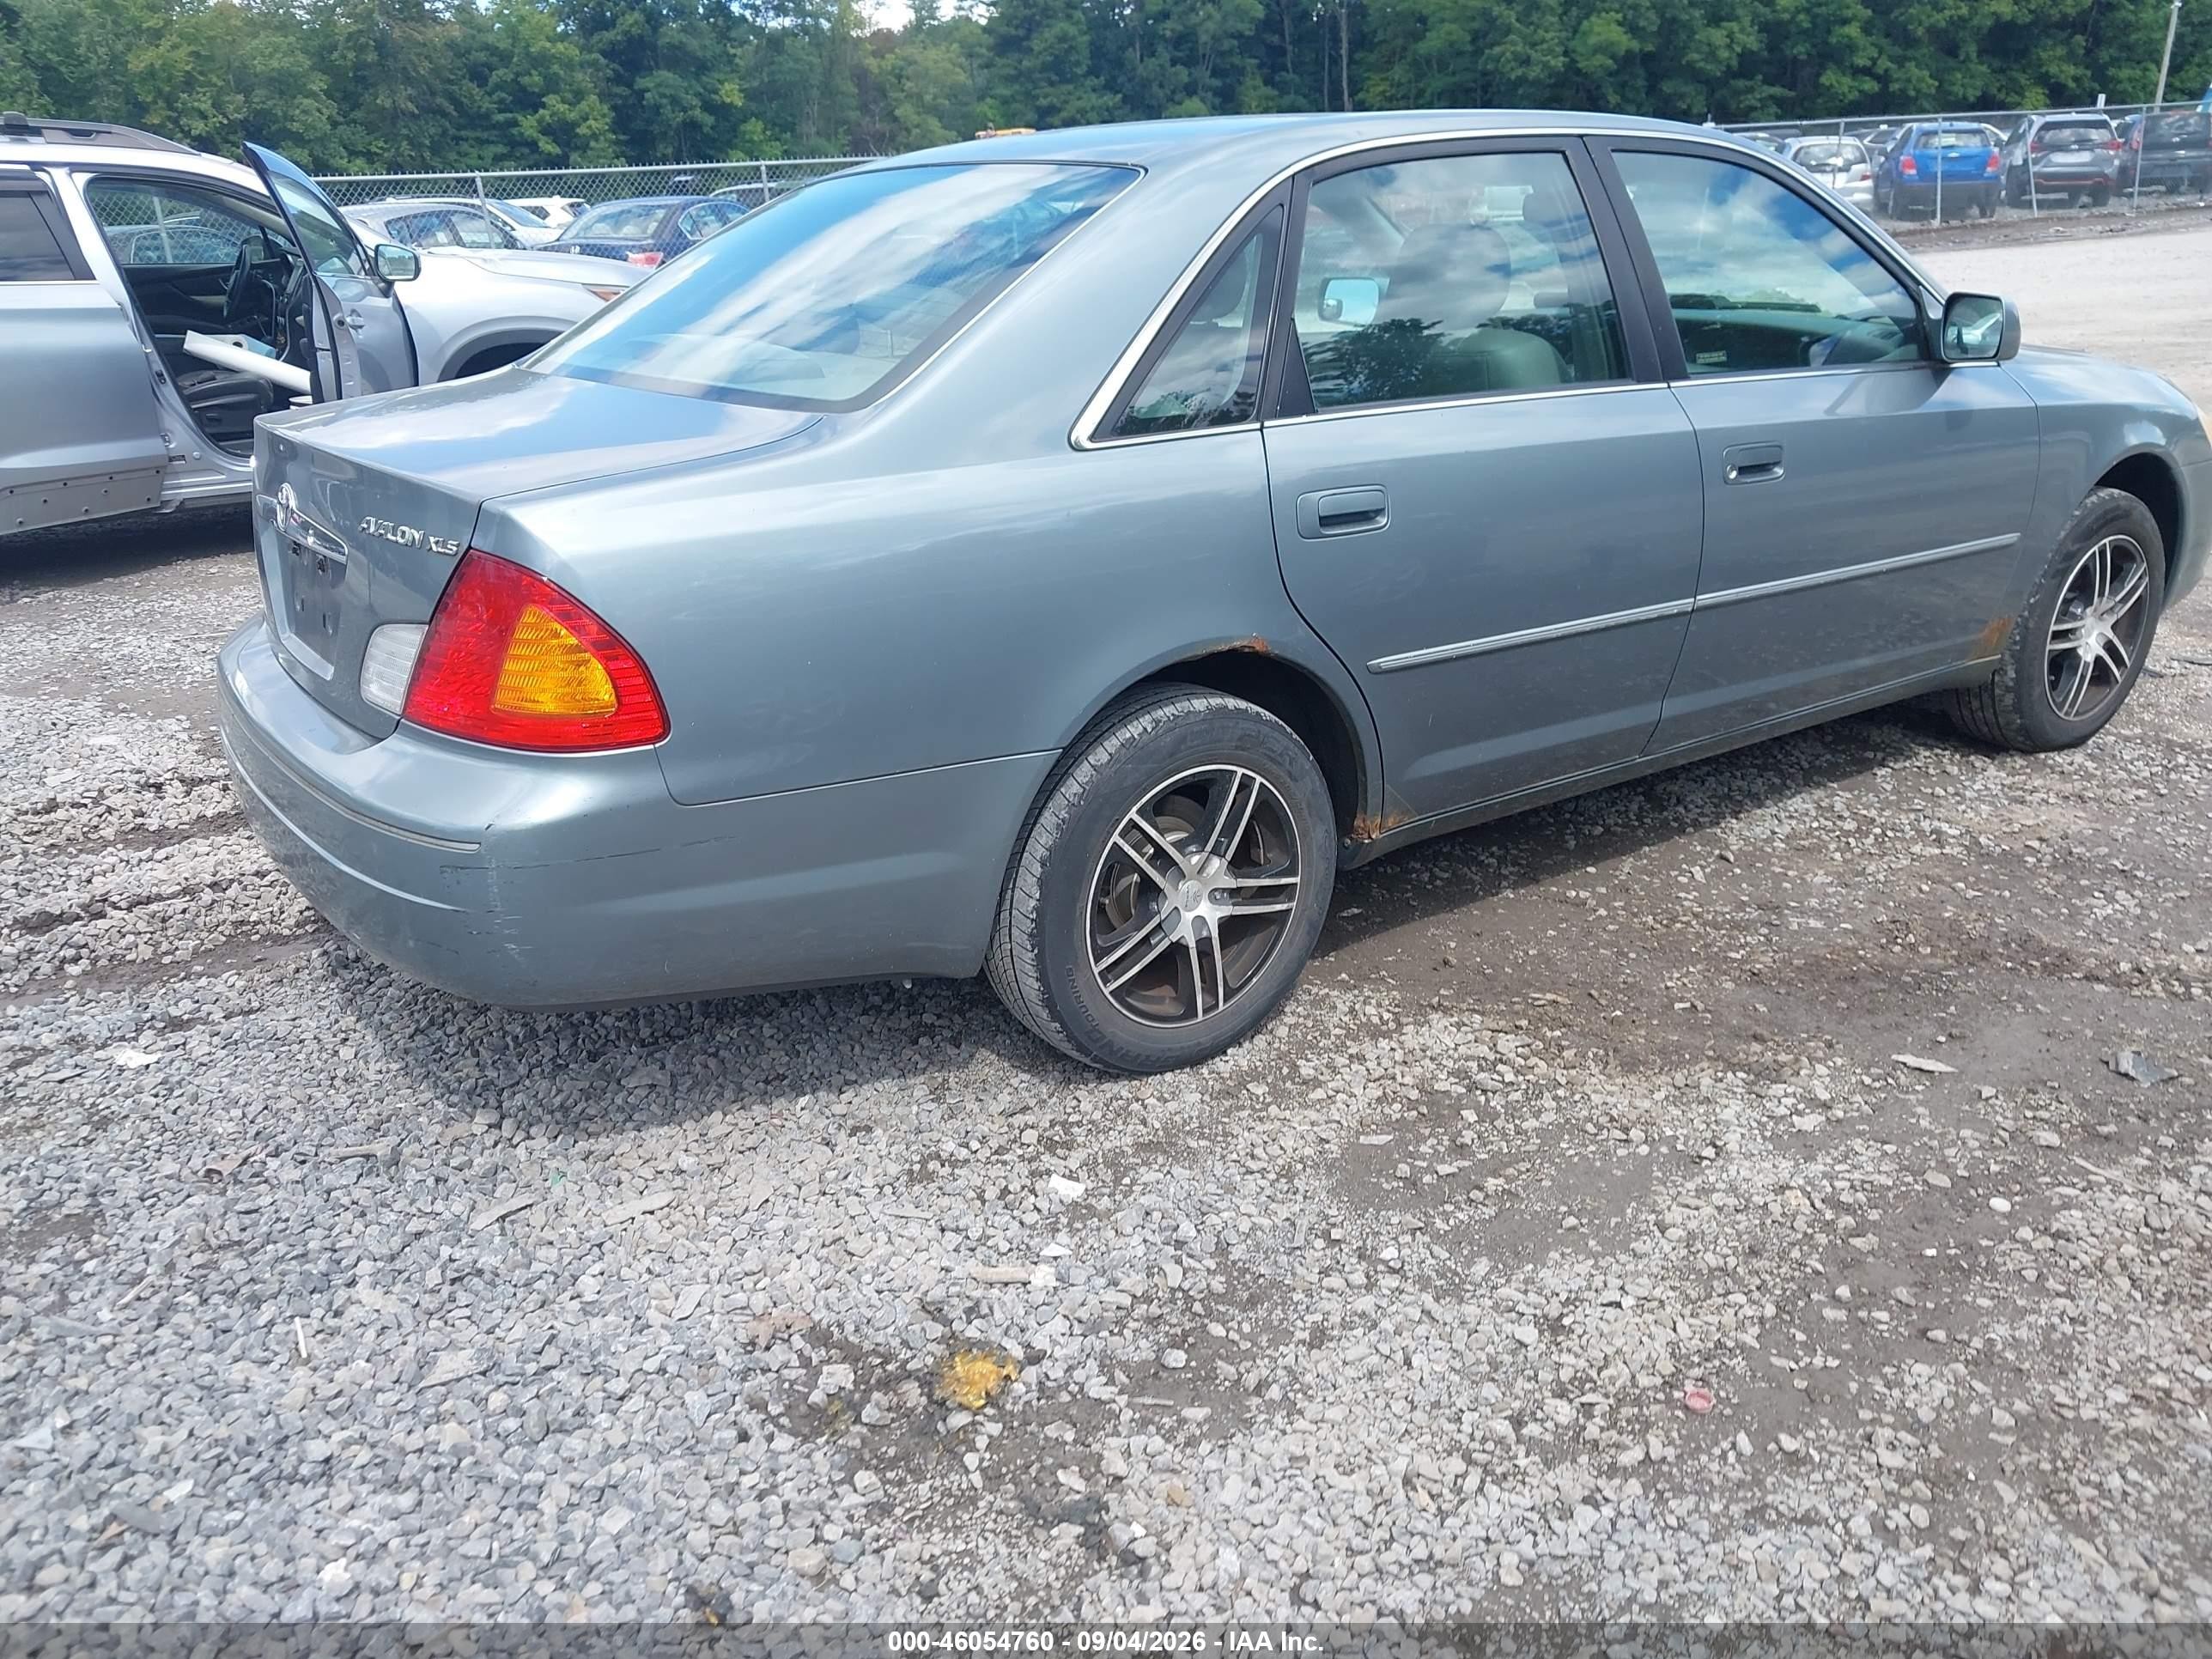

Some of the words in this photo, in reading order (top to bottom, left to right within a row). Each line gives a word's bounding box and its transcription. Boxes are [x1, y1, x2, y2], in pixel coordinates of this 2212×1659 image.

[358, 516, 425, 549] AVALON
[427, 536, 460, 556] XLS
[1065, 964, 1100, 1030] TOURING
